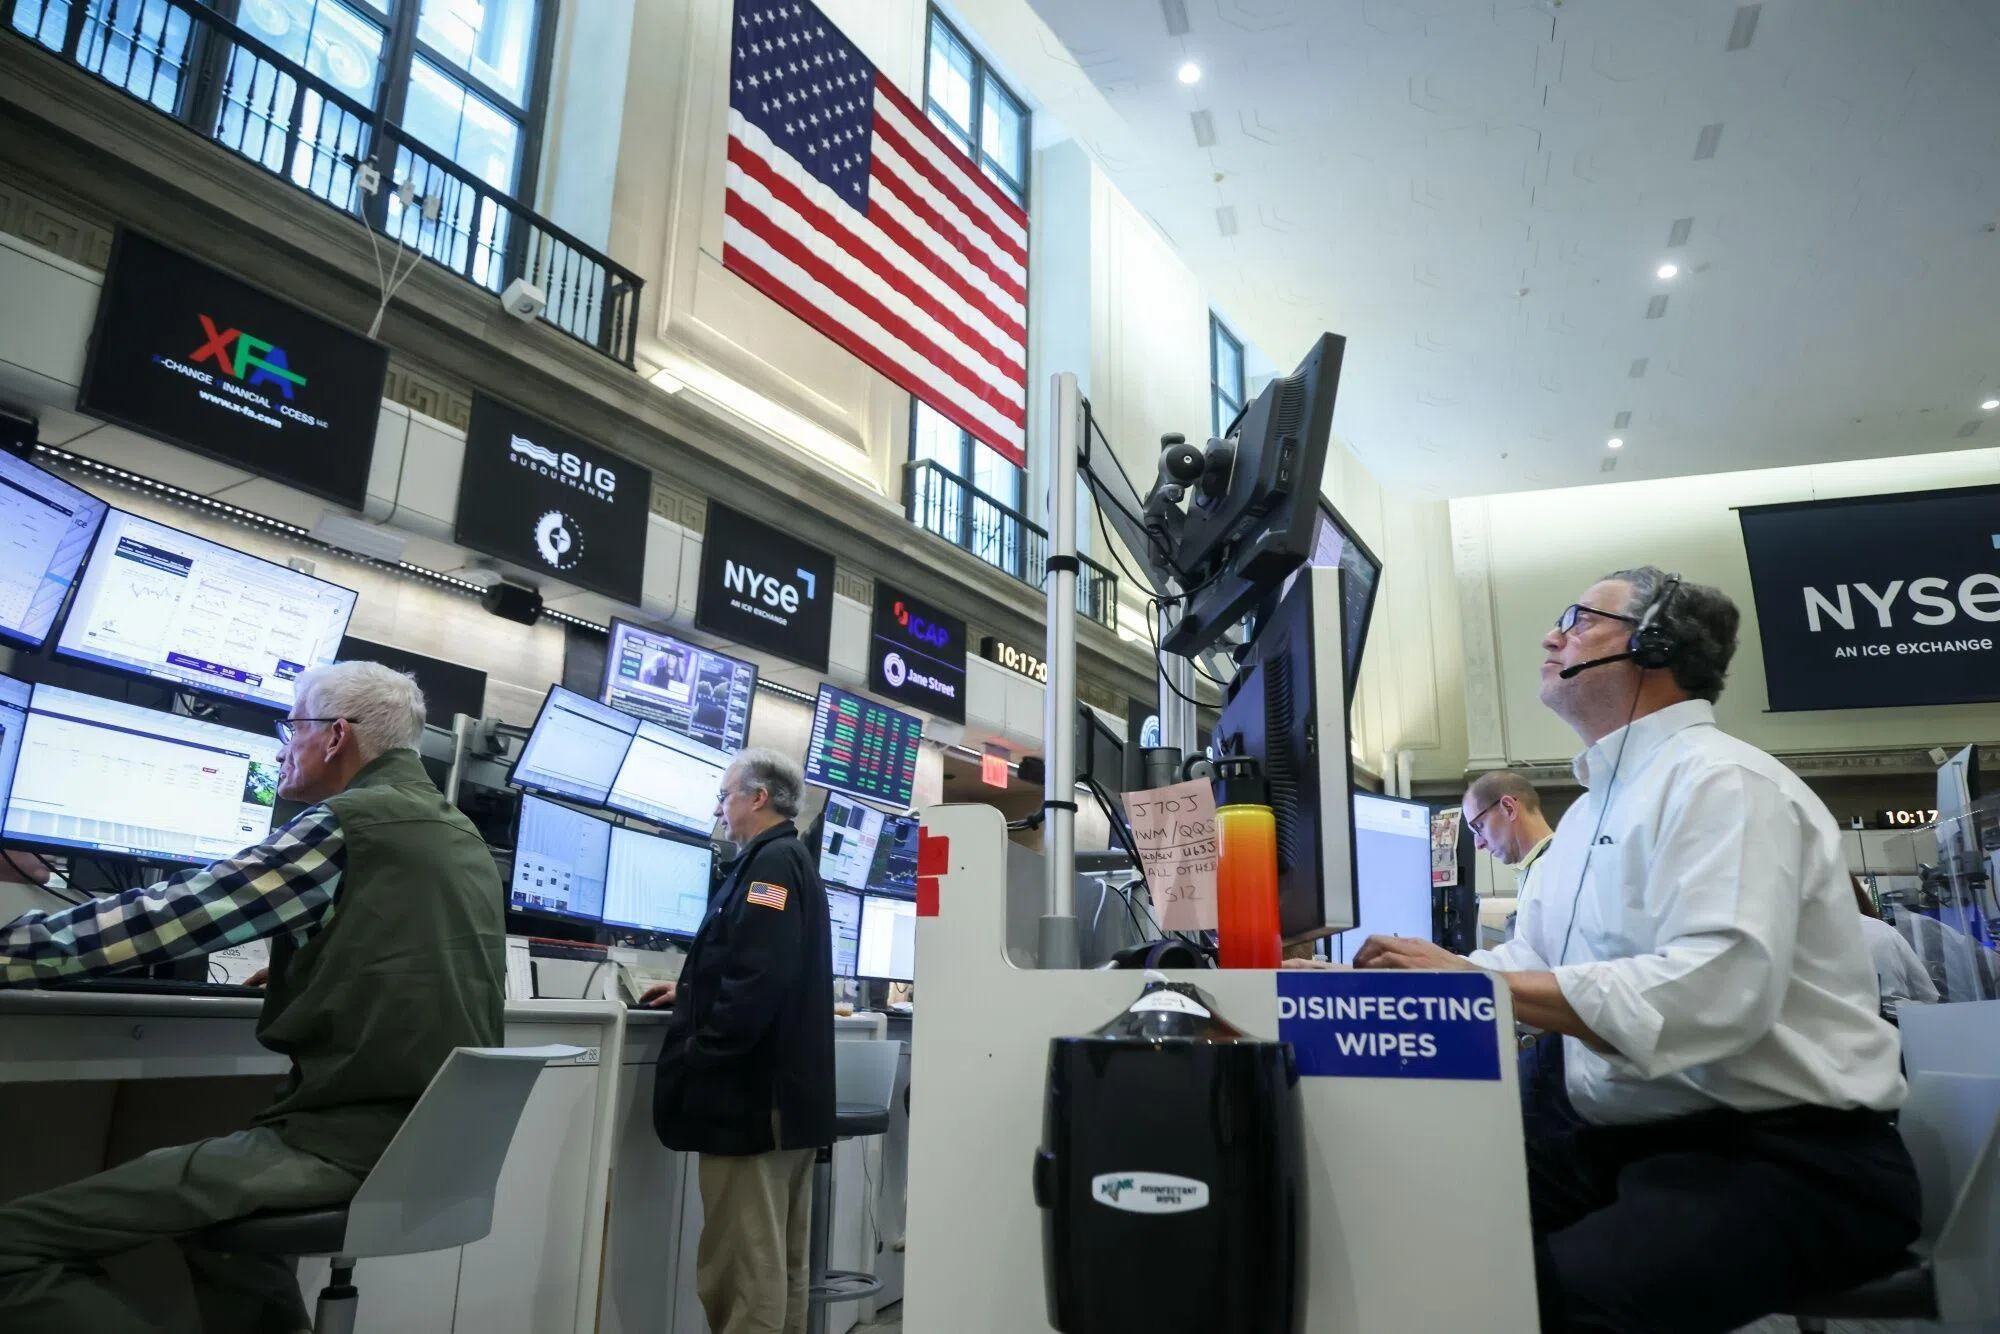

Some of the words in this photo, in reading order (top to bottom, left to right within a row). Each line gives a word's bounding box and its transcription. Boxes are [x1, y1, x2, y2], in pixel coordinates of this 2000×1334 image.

[188, 313, 308, 400] XFA
[152, 354, 214, 385] -CHANGE
[215, 379, 271, 408] INANCIAL
[274, 403, 315, 426] CCESS
[199, 390, 283, 428] www.x-fa.com
[510, 452, 614, 504] SUSQUEHANNA
[560, 452, 616, 493] SIG
[908, 612, 949, 648] ICAP
[1834, 646, 1858, 658] AN
[907, 668, 928, 687] Jane
[928, 676, 955, 698] Street
[1886, 810, 1939, 824] 10:17
[1278, 996, 1496, 1021] DISINFECTING
[1335, 1032, 1438, 1058] WIPES
